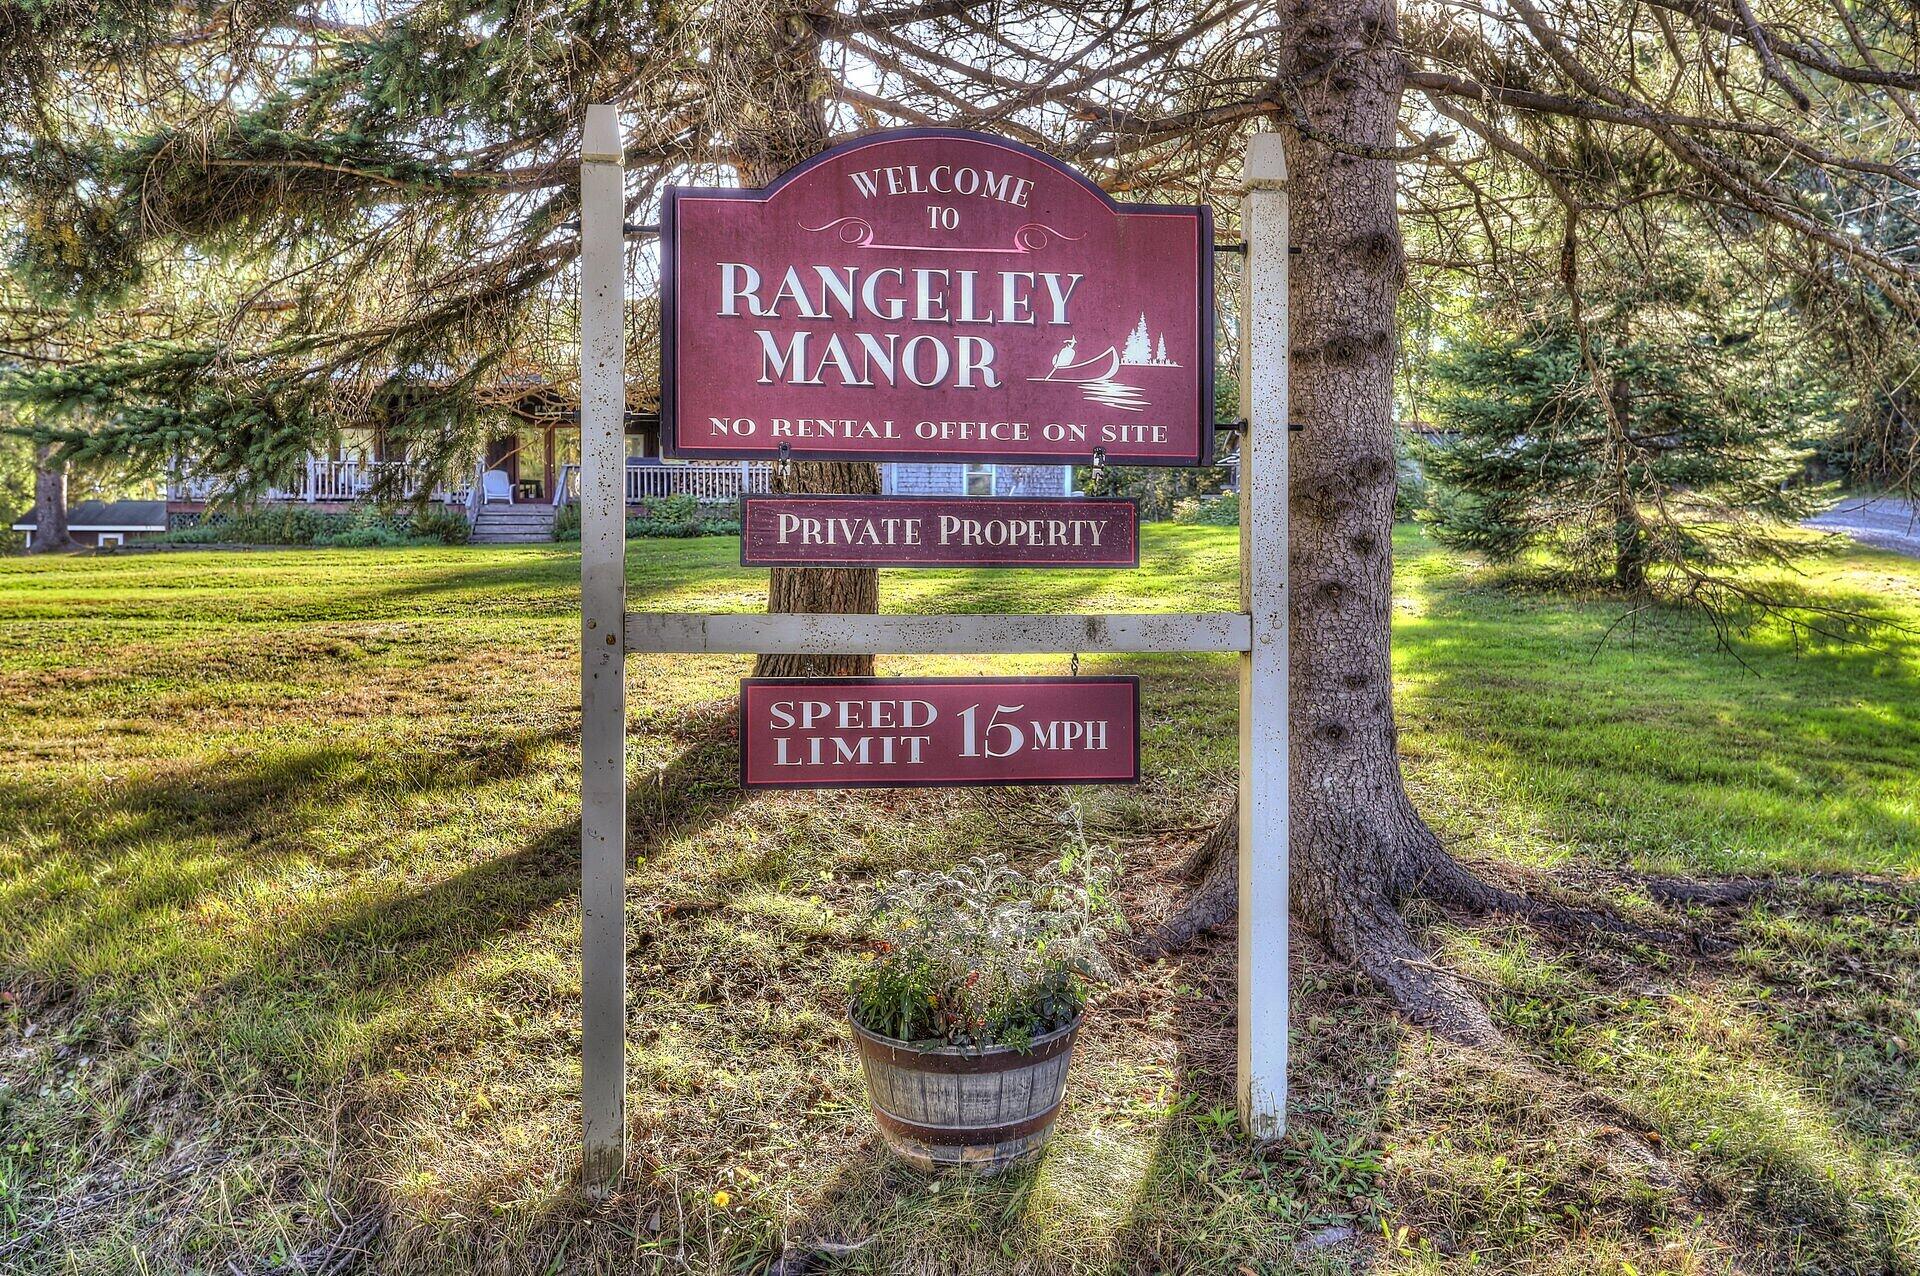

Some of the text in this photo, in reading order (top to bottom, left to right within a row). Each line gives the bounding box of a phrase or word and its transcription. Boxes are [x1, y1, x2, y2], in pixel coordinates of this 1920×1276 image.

[848, 164, 1036, 209] WELCOME
[926, 205, 960, 230] TO
[715, 262, 1084, 326] RANGELEY
[754, 330, 1002, 389] MANOR
[709, 417, 1168, 444] NO RENTAL OFFICE ON SITE
[776, 513, 1109, 547] PRIVATE PROPERTY
[769, 700, 939, 730] SPEED
[956, 703, 1109, 759] 15 MPH
[773, 736, 930, 766] LIMIT
